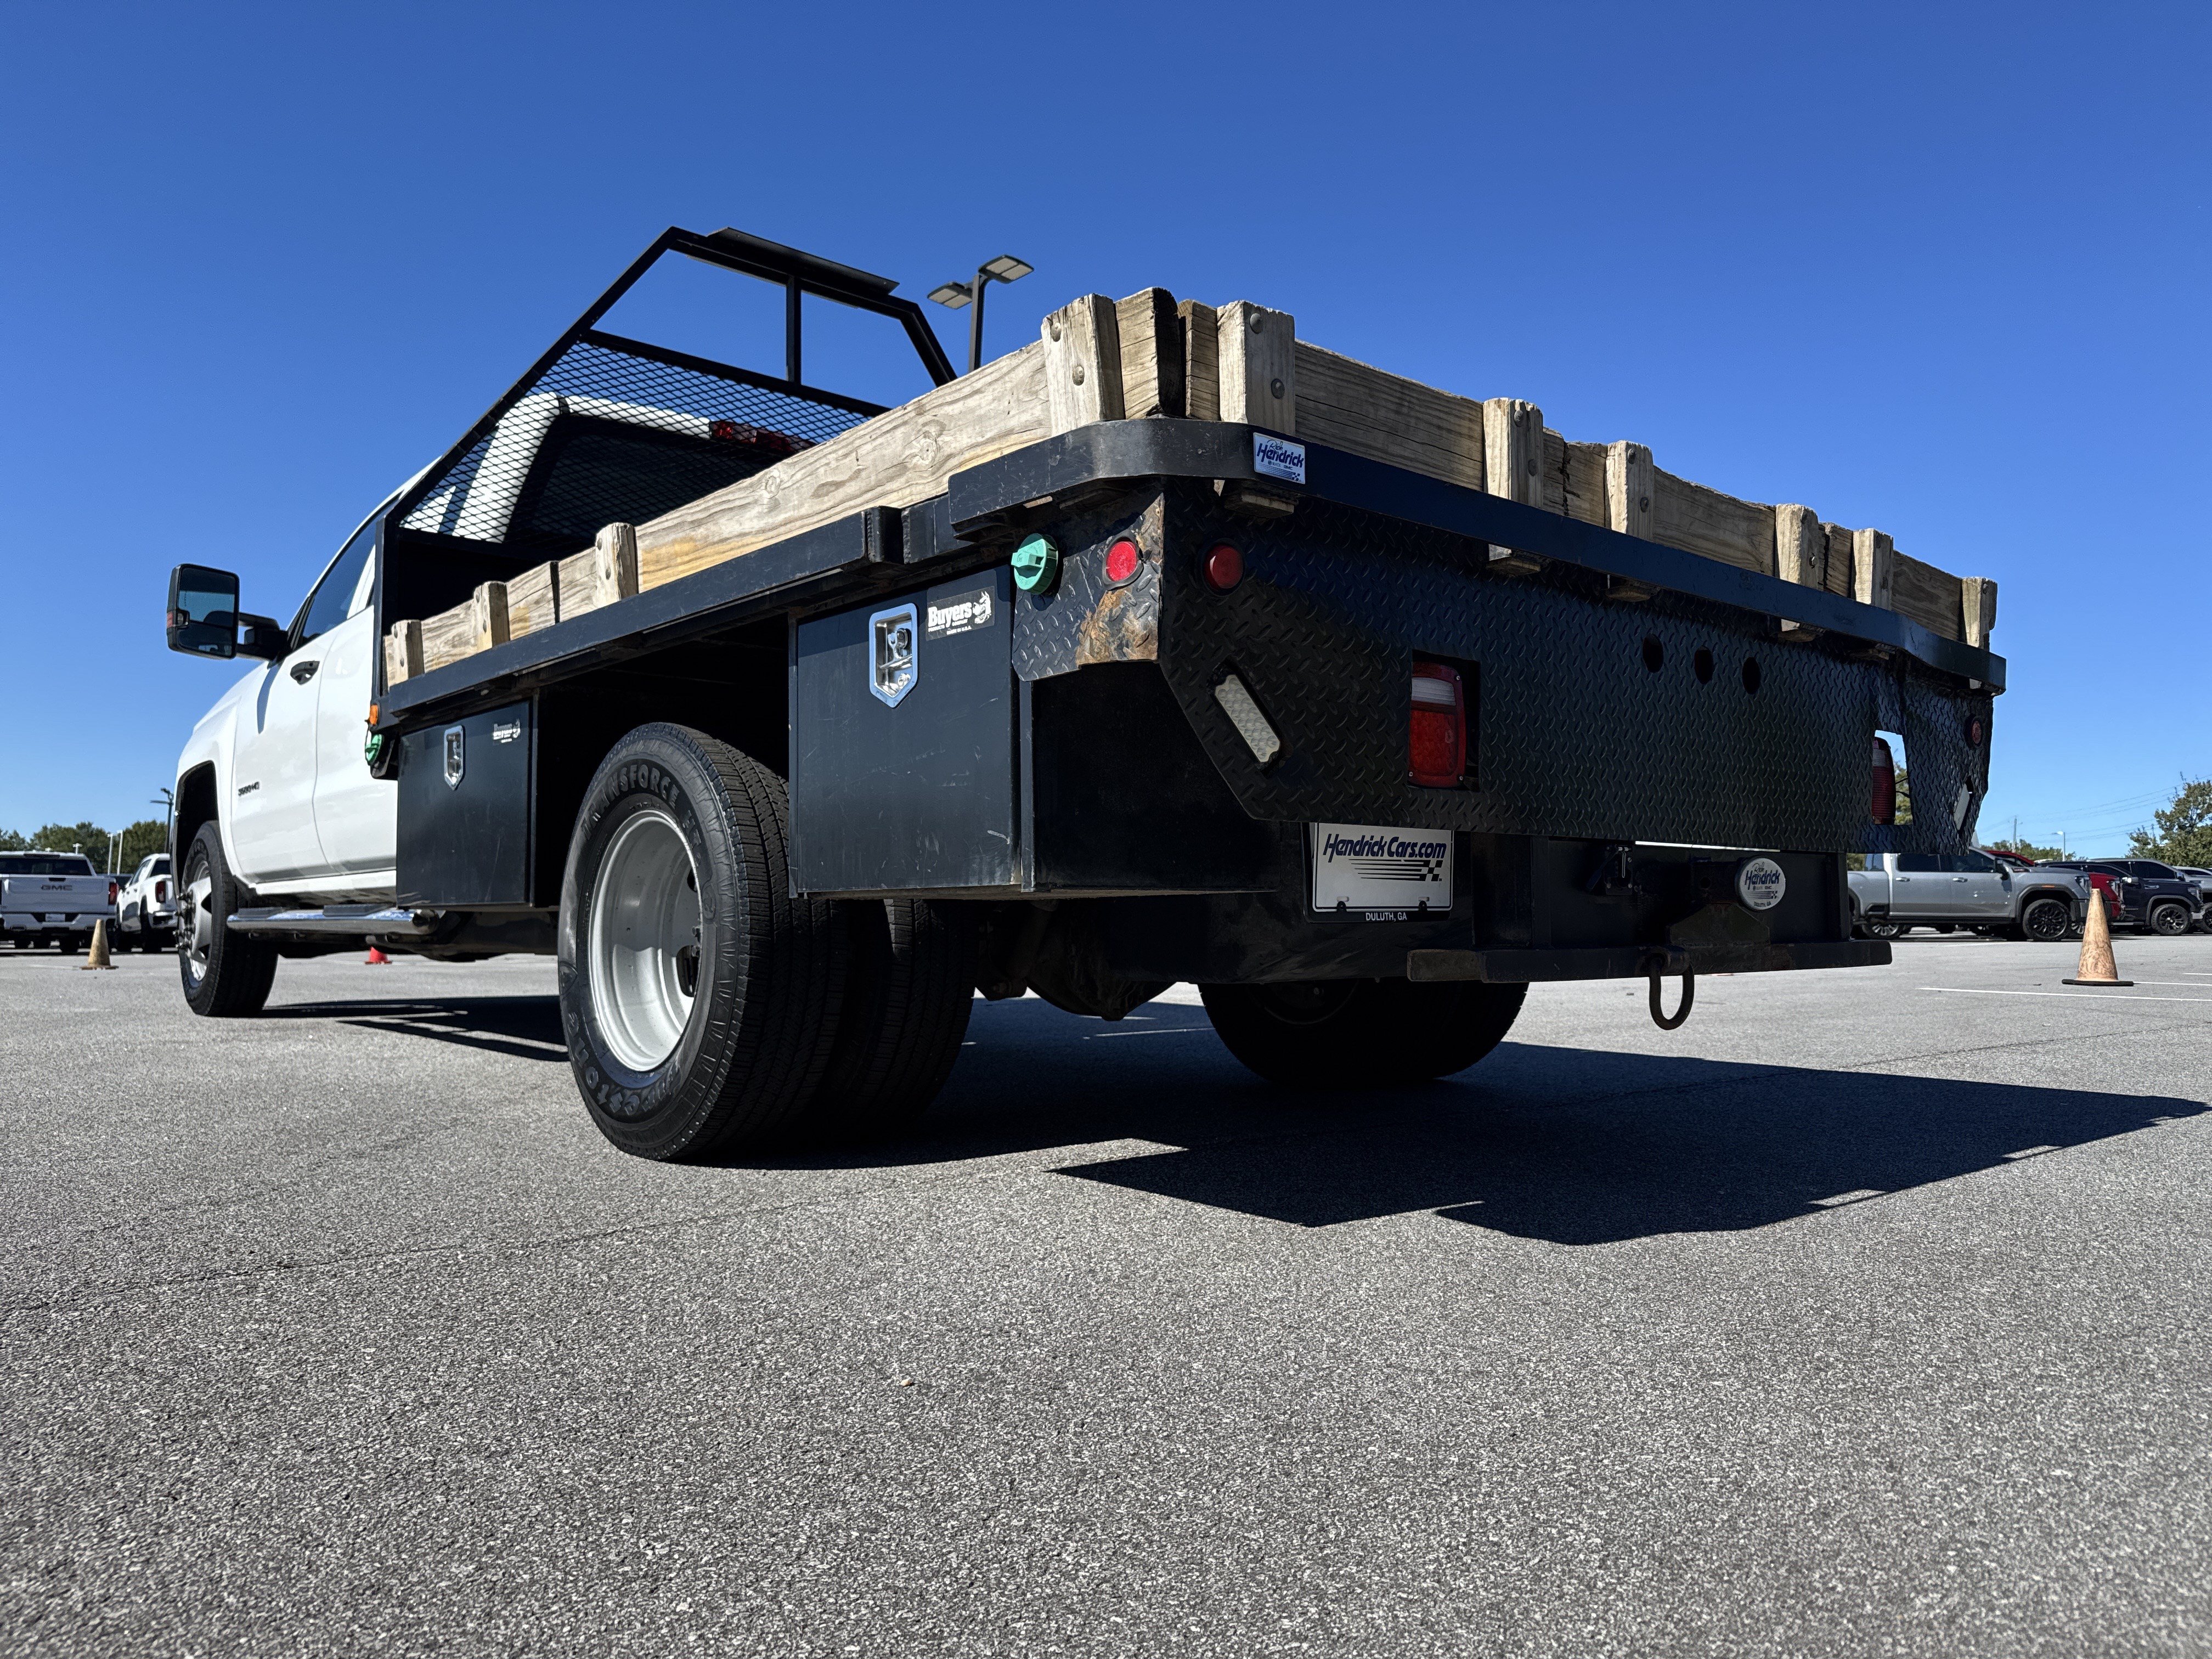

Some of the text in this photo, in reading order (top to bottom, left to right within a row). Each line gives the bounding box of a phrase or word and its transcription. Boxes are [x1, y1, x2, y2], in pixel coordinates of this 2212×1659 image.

[1257, 443, 1304, 468] Hendrick
[928, 602, 972, 628] Buyers
[580, 764, 680, 841] TRANSFORCE
[1745, 870, 1781, 890] Hendrick
[1365, 912, 1407, 921] DULUTH, GA
